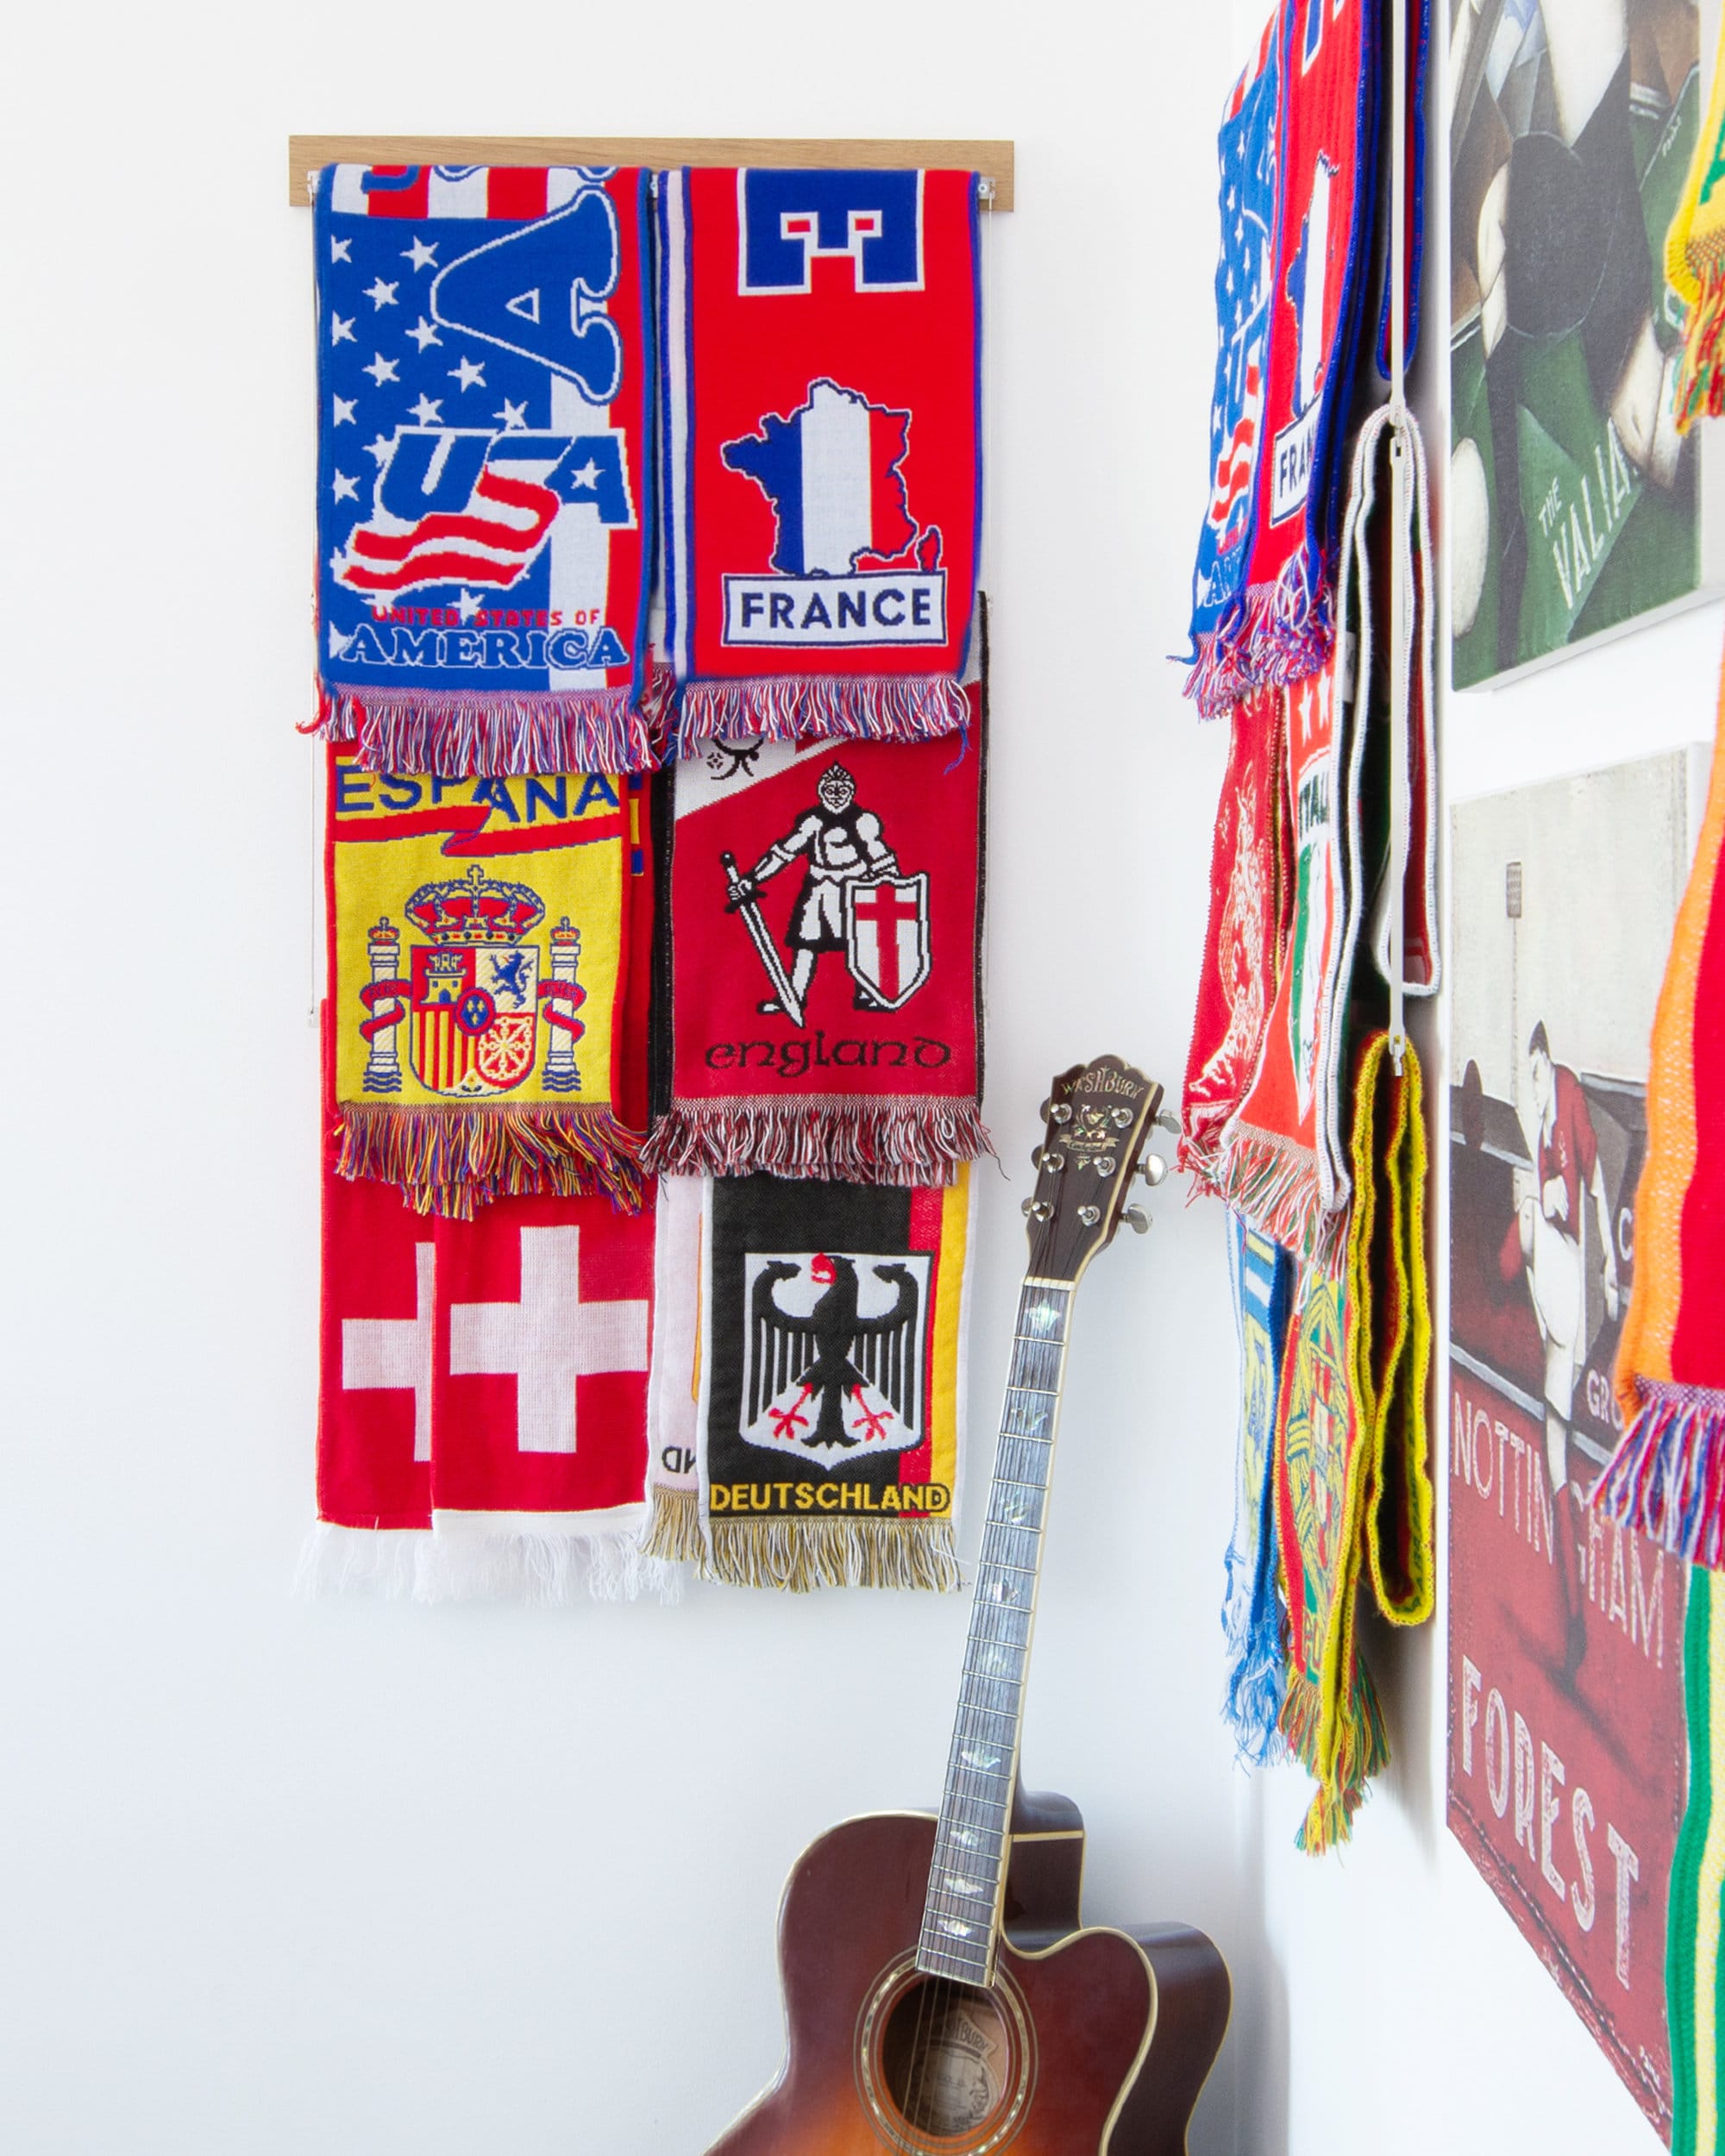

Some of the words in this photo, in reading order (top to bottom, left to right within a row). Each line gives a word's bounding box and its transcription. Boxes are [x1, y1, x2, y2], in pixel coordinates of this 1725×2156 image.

[341, 425, 638, 592] USA
[1539, 477, 1562, 538] THE
[1553, 417, 1638, 610] VALIA
[372, 605, 459, 626] UNITED
[474, 606, 563, 627] STATES
[574, 609, 600, 625] OF
[741, 588, 931, 629] FRANCE
[340, 624, 630, 670] AMERICA
[706, 1031, 951, 1078] england
[1062, 1066, 1145, 1100] WASHBURN
[710, 1482, 950, 1512] DEUTSCHLAND
[1463, 1654, 1640, 1990] FOREST
